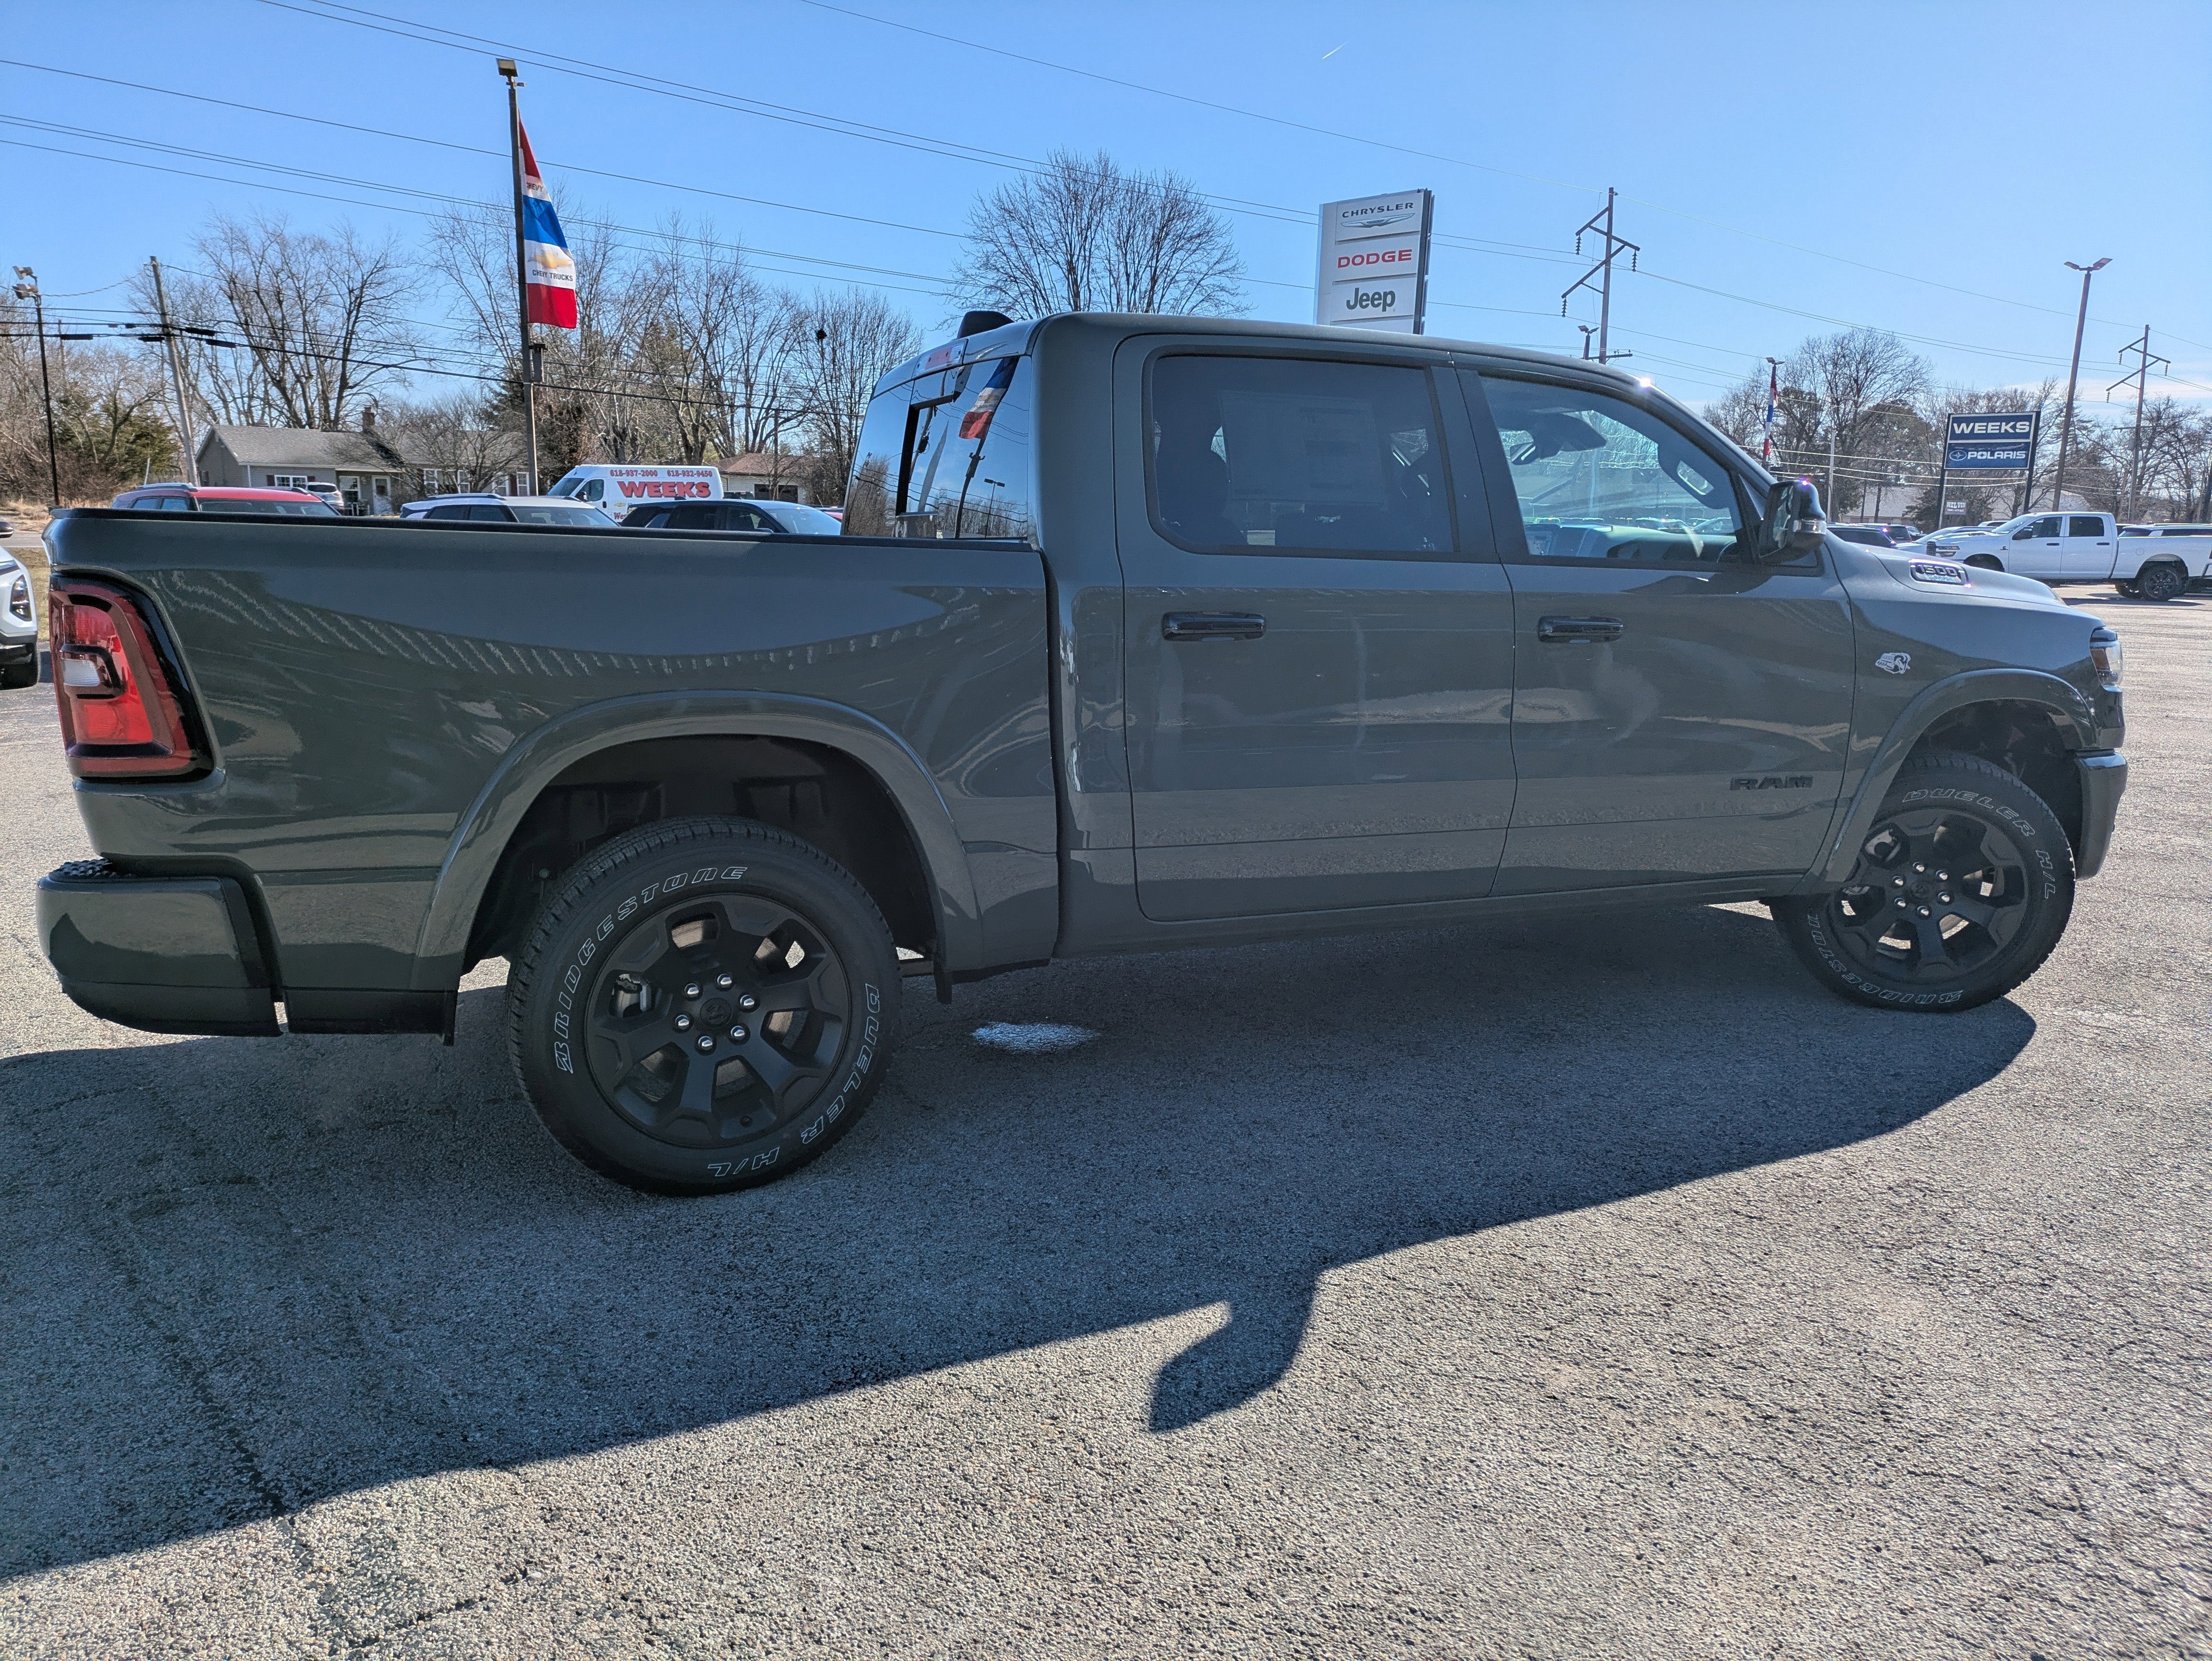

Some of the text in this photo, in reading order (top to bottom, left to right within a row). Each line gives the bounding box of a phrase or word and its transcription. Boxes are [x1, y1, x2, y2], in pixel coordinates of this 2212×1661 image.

[1342, 202, 1413, 218] CHRYSLER
[1338, 249, 1412, 268] DODGE
[549, 272, 573, 281] TRUCKS
[1346, 288, 1395, 312] Jeep
[1953, 421, 2029, 433] WEEKS
[1968, 451, 2025, 459] POLARIS
[617, 481, 711, 498] WEEKS
[1917, 564, 1958, 576] 1500
[1730, 776, 1814, 790] RAM
[1902, 788, 2036, 837] DUELER
[1808, 914, 1963, 1005] BRIDGESTON
[554, 866, 748, 1074] BRIDGESTONE
[708, 983, 880, 1177] DUELER H/L
